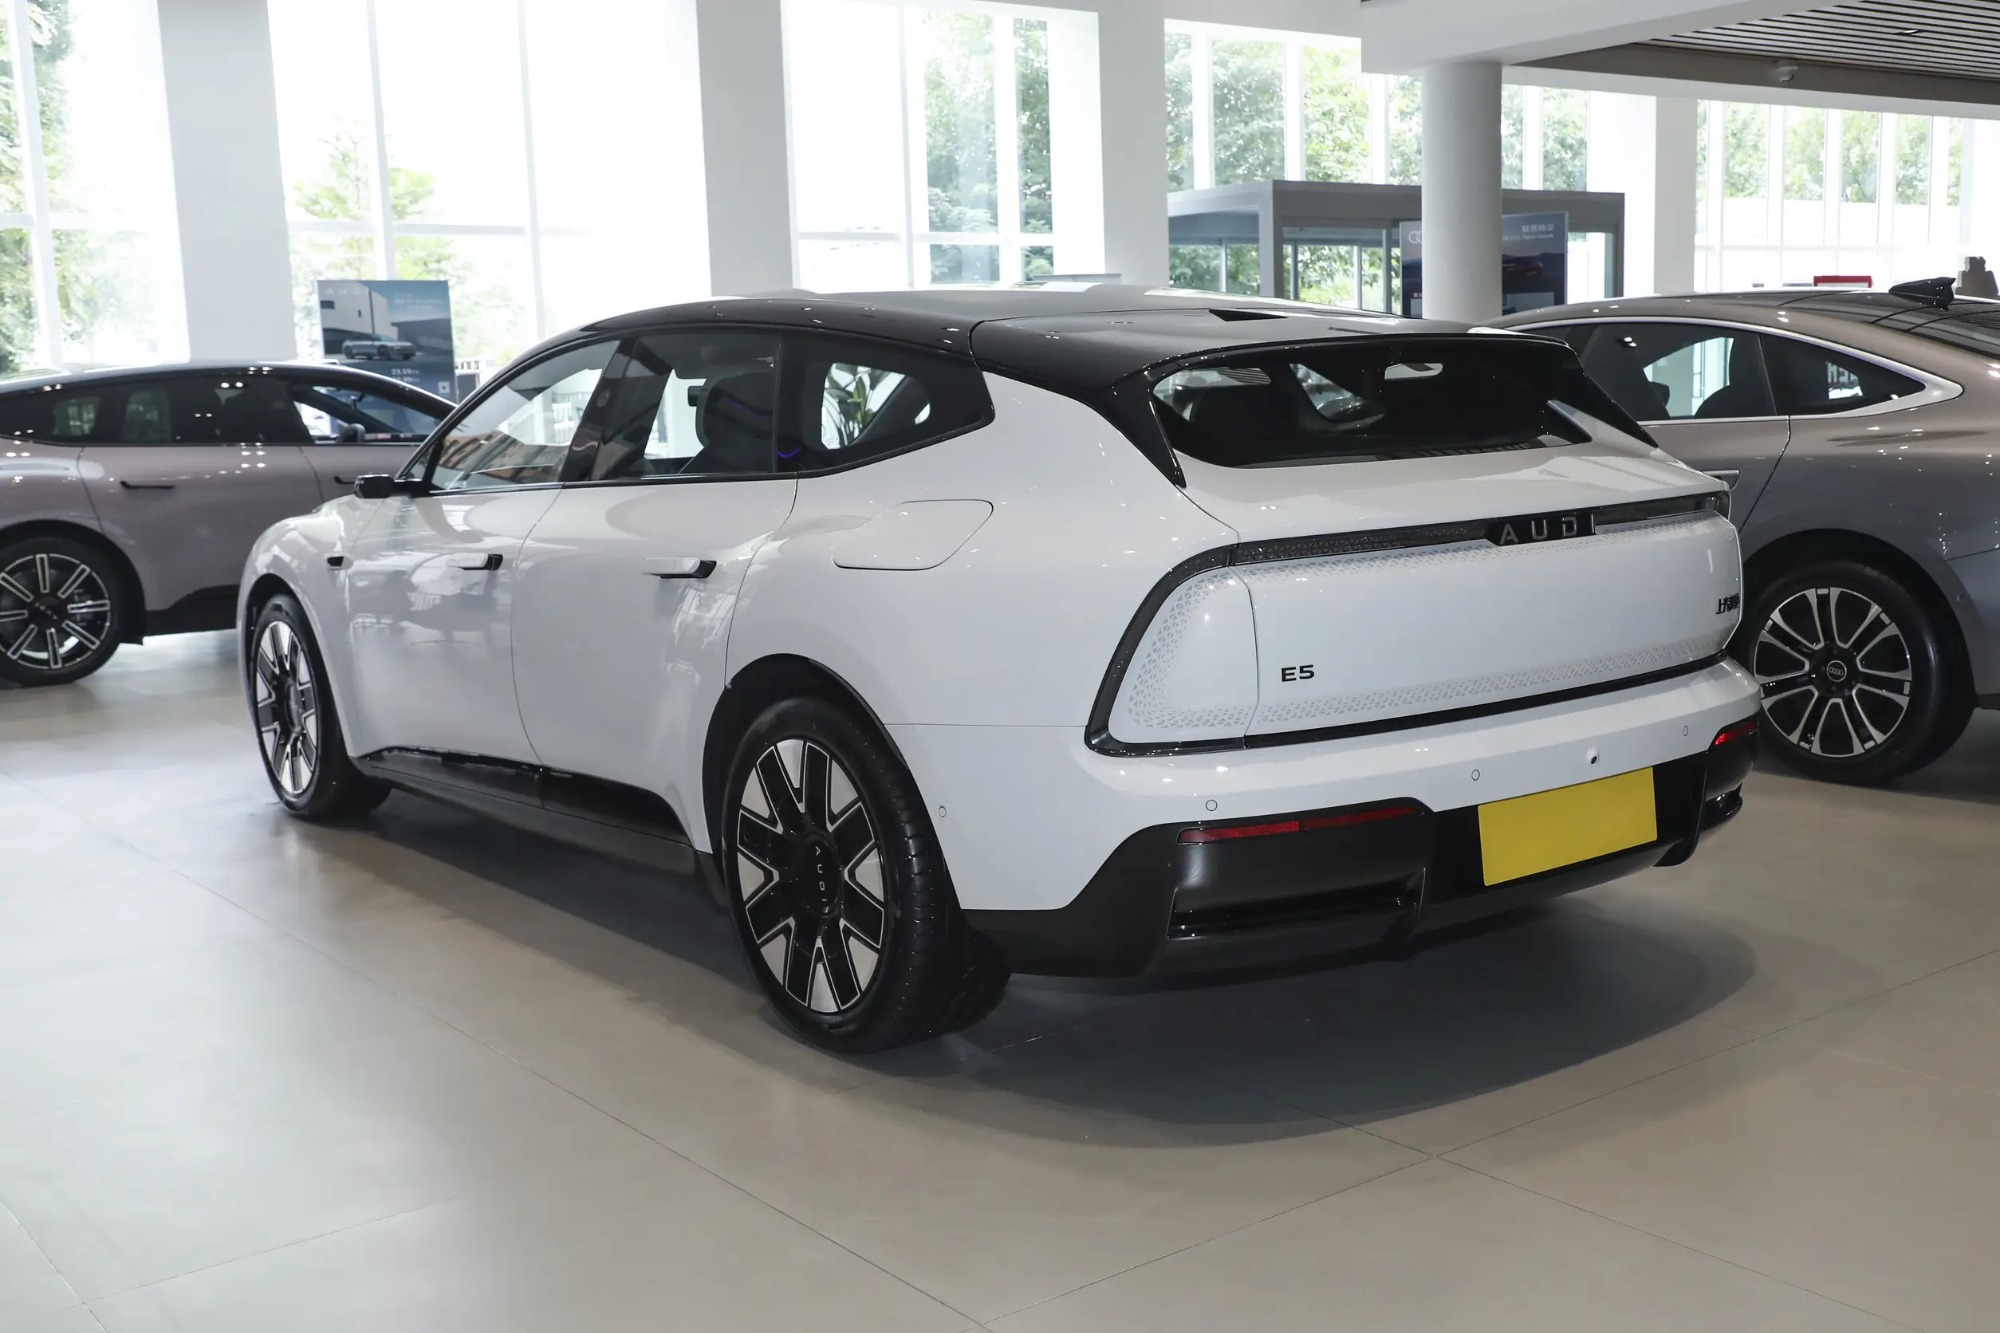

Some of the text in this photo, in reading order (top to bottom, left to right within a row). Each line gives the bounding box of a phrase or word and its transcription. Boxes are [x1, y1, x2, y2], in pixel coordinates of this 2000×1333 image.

[1500, 514, 1595, 545] AUDI
[1281, 664, 1314, 682] E5
[815, 845, 827, 902] AUDI
